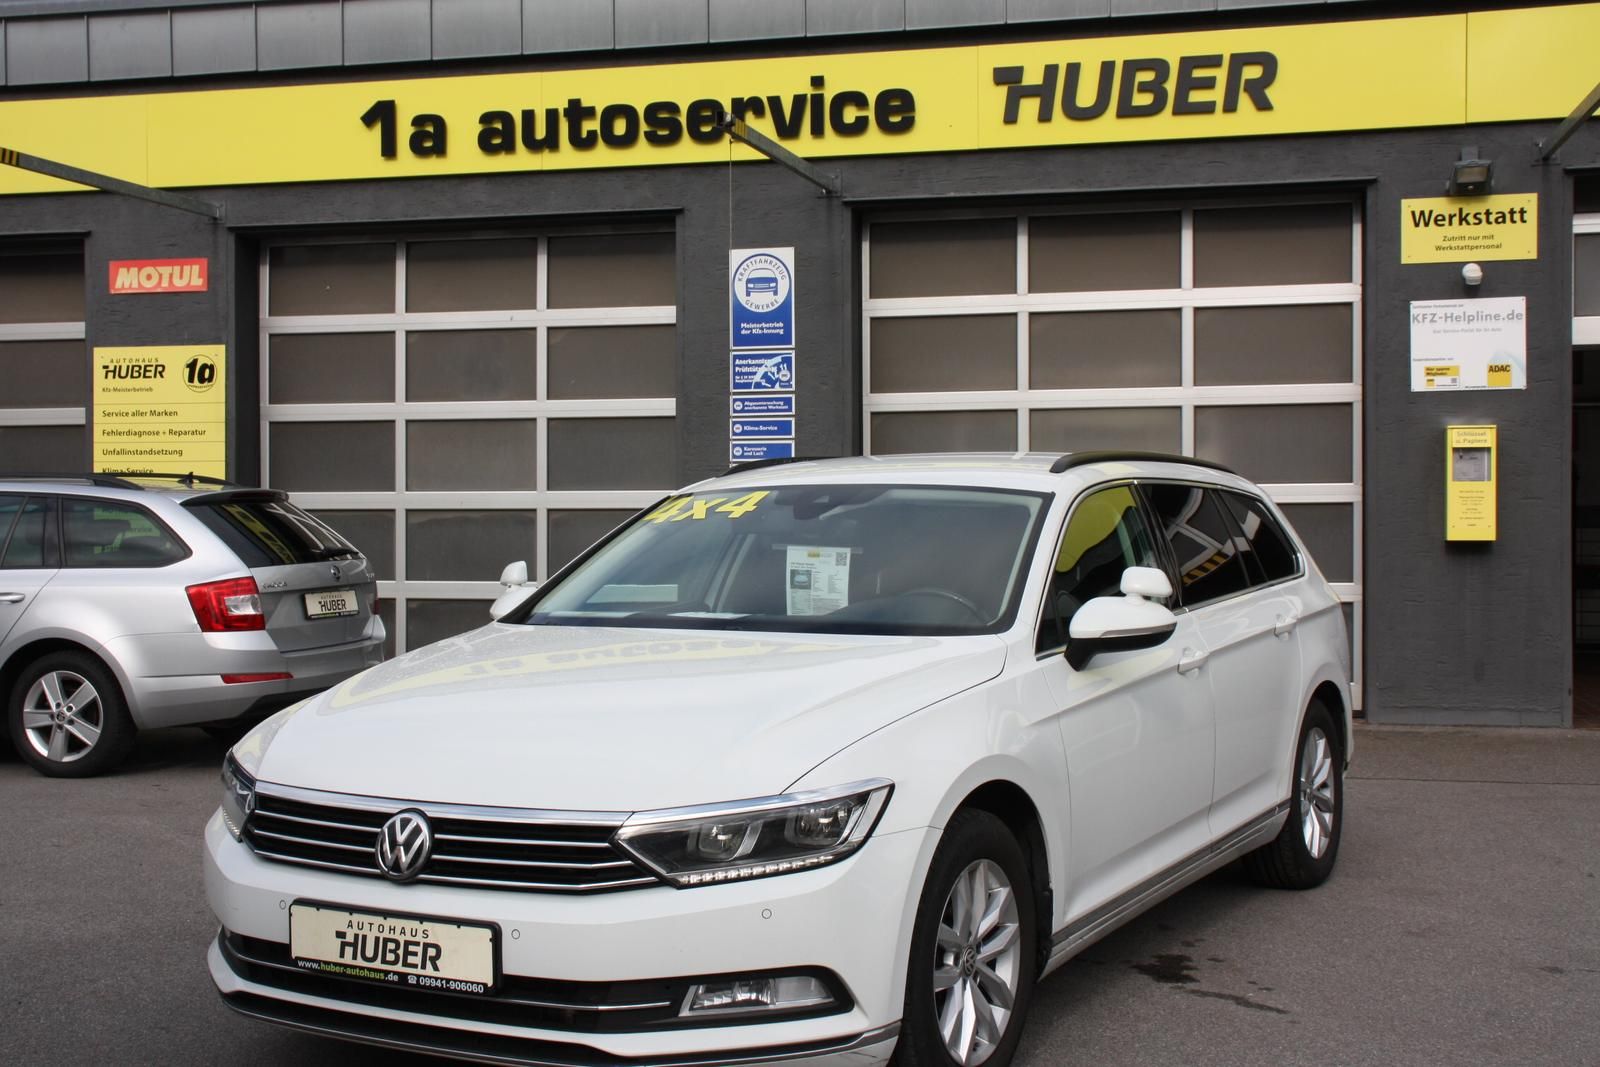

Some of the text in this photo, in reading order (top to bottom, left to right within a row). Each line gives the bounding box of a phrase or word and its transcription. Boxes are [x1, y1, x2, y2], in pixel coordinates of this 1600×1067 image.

[993, 51, 1278, 124] HUBER
[360, 75, 916, 159] 1a autoservice
[1410, 207, 1527, 228] Werkstatt
[1435, 243, 1502, 251] Werkstattpersonal
[115, 264, 204, 289] MOTUL
[738, 258, 787, 282] KRAFTFAHRZEUG
[745, 299, 780, 310] GEWERBE
[1412, 309, 1524, 325] KFZ-Helpline.de
[102, 358, 215, 384] HUBER 1a
[1488, 364, 1511, 373] ADAC
[102, 409, 129, 417] Service
[131, 409, 147, 417] aller
[102, 429, 160, 437] Fehlerdiagnose
[168, 428, 206, 437] Reparatur
[102, 448, 183, 457] Unfallinstandsetzung
[644, 490, 770, 524] 4x4
[318, 598, 347, 612] HUBER
[346, 919, 430, 939] AUTOHAUS
[335, 930, 442, 972] HUBER
[297, 959, 484, 994] www.huber-autohaus.de 09941-906060
